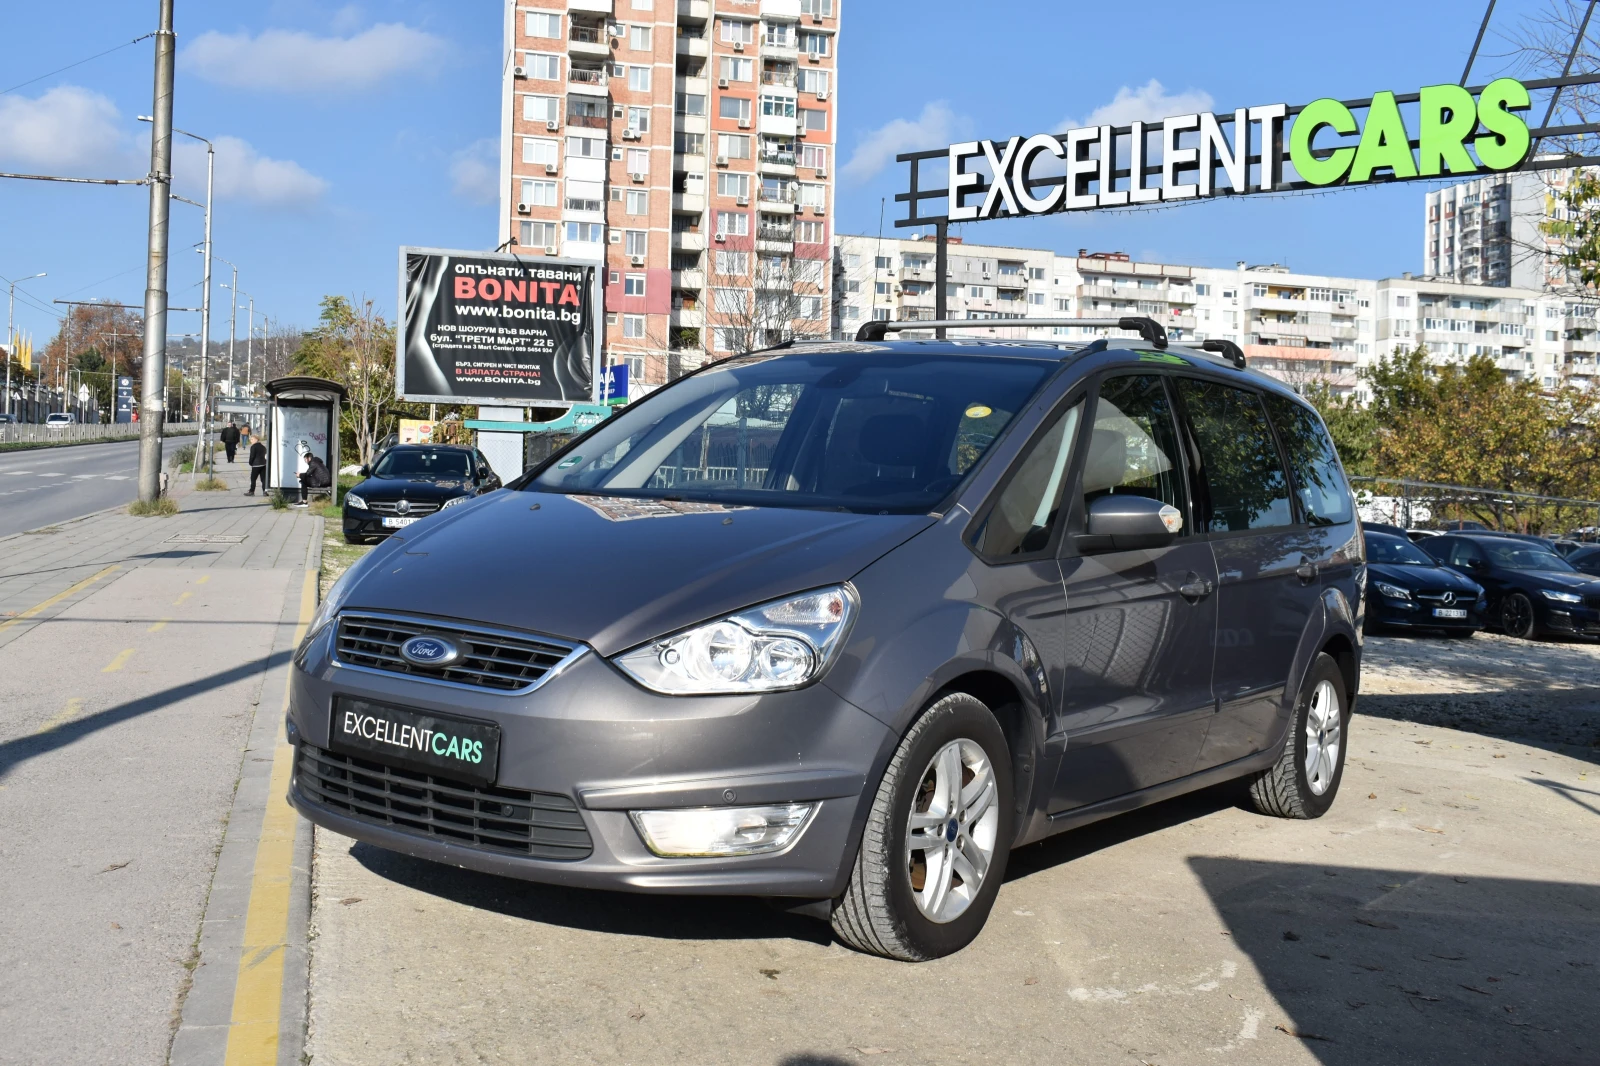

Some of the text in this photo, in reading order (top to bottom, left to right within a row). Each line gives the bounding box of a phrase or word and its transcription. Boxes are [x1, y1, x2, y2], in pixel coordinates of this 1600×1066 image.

[455, 264, 524, 277] опънати
[529, 268, 581, 281] тавани
[454, 276, 580, 306] BONITA
[455, 305, 580, 325] www.bonita.bg
[437, 324, 548, 336] НОВ ШОУРУМ ВЪВ ВАРНА
[430, 333, 453, 343] бул.
[533, 338, 545, 347] 22
[546, 339, 555, 347] Б
[464, 368, 501, 376] ЦЯЛАТА
[456, 377, 541, 386] www.BONITA.bg
[411, 641, 438, 657] Ford
